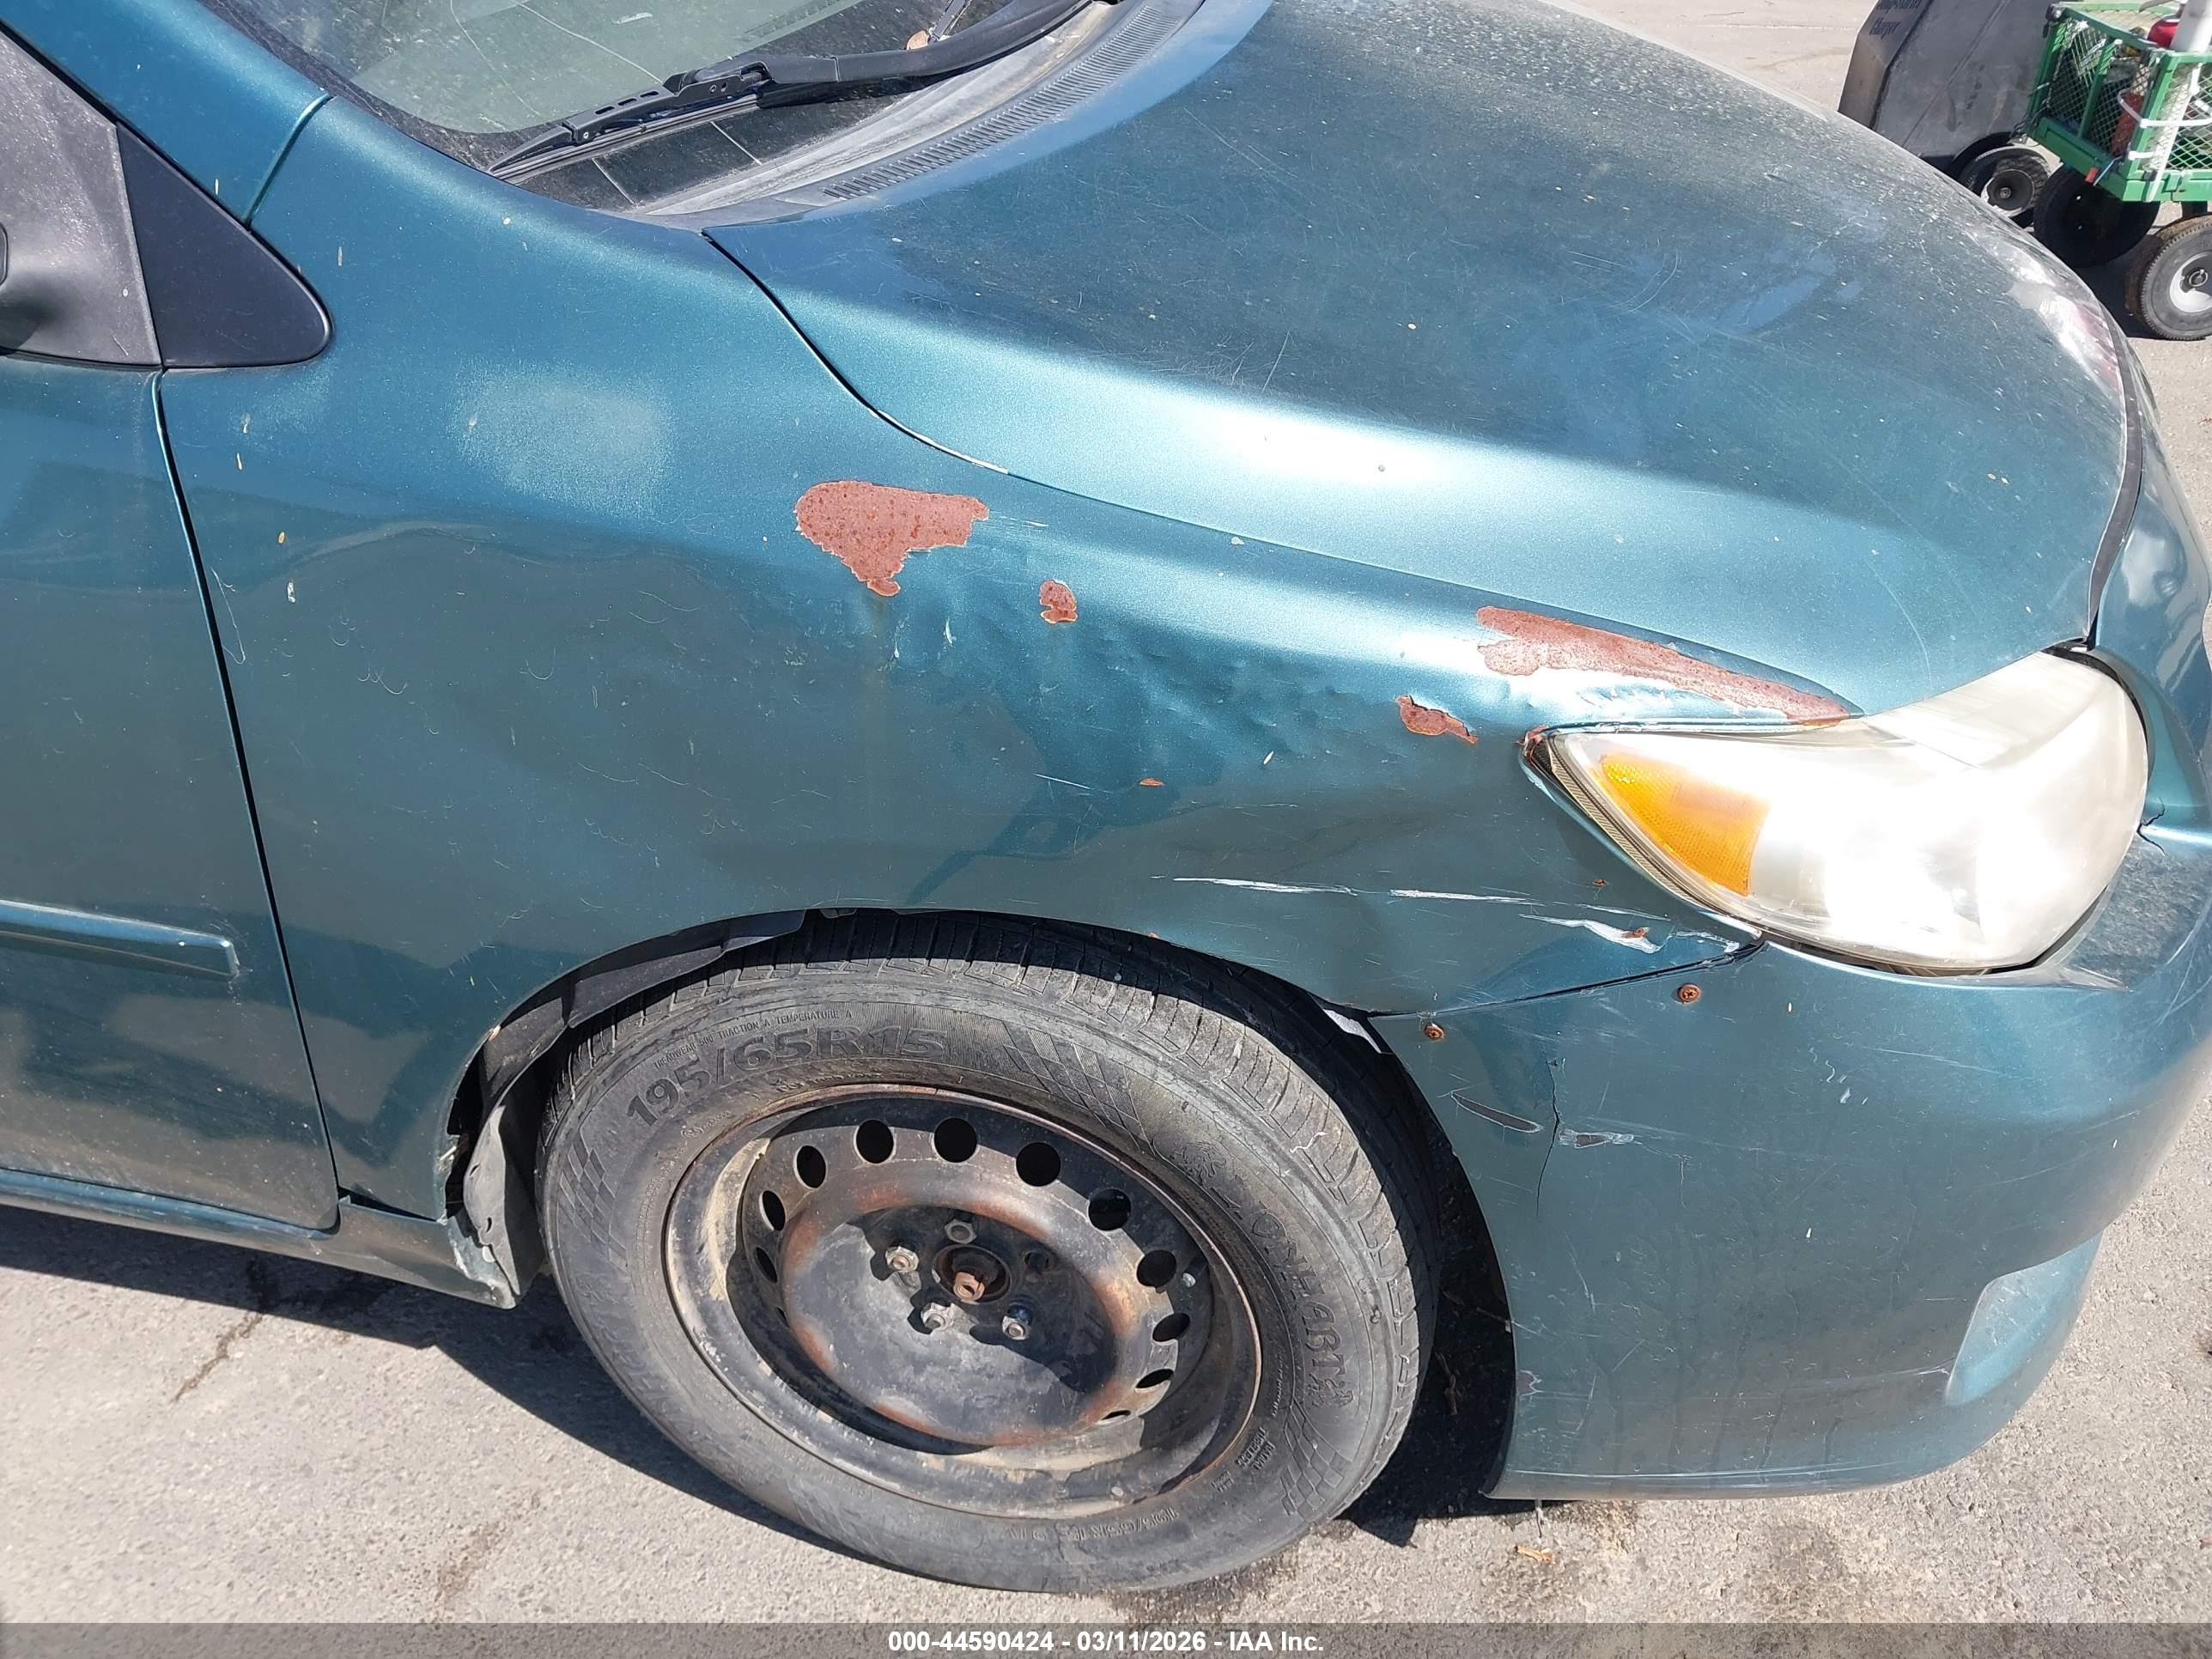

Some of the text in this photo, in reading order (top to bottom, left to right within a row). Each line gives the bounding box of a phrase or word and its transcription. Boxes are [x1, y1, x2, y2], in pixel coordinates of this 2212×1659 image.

[718, 1020, 759, 1040] TRACTION
[775, 1009, 840, 1024] TEMPERATURE
[626, 1024, 947, 1127] 195/65R15
